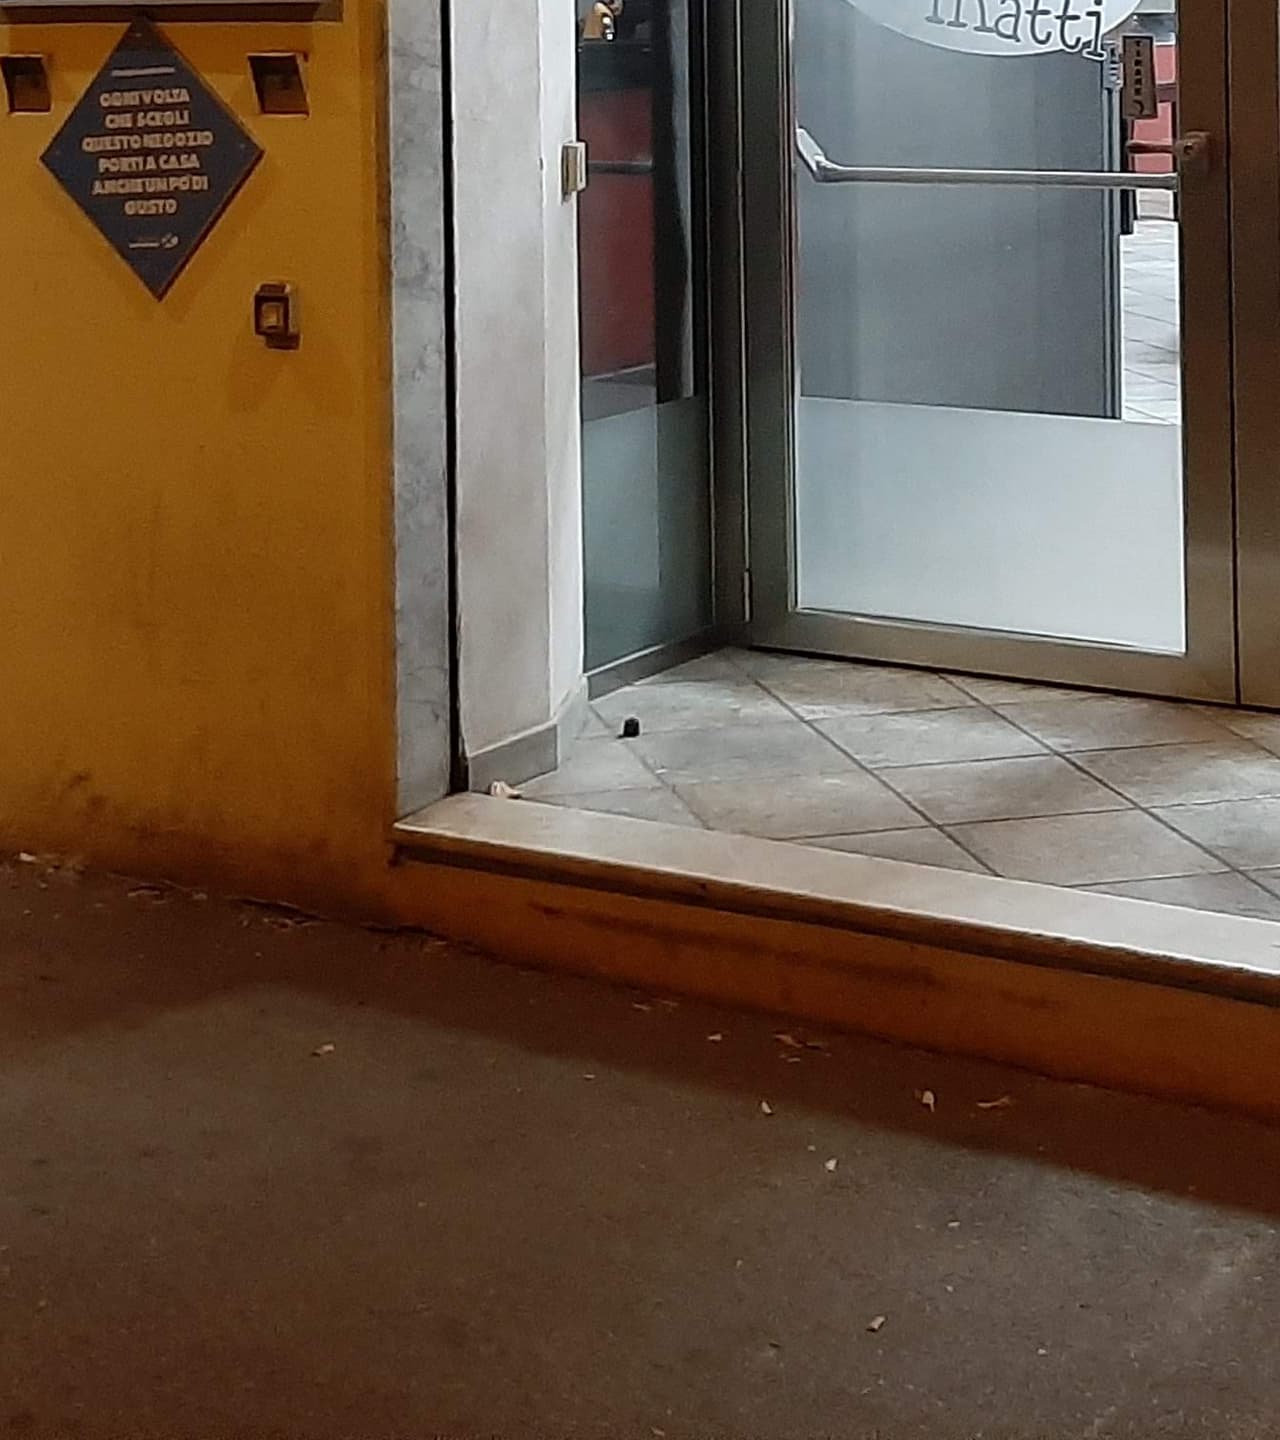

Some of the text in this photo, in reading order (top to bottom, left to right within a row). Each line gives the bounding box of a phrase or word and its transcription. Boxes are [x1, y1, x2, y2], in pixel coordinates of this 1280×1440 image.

[140, 88, 190, 104] VOLTA
[105, 114, 133, 128] CHE
[82, 131, 213, 151] QUESTO NEGOZIO
[160, 154, 199, 169] CASA
[92, 178, 143, 194] ANCHE
[144, 177, 168, 192] UN
[192, 175, 208, 190] DI
[125, 199, 176, 215] GUSTO
